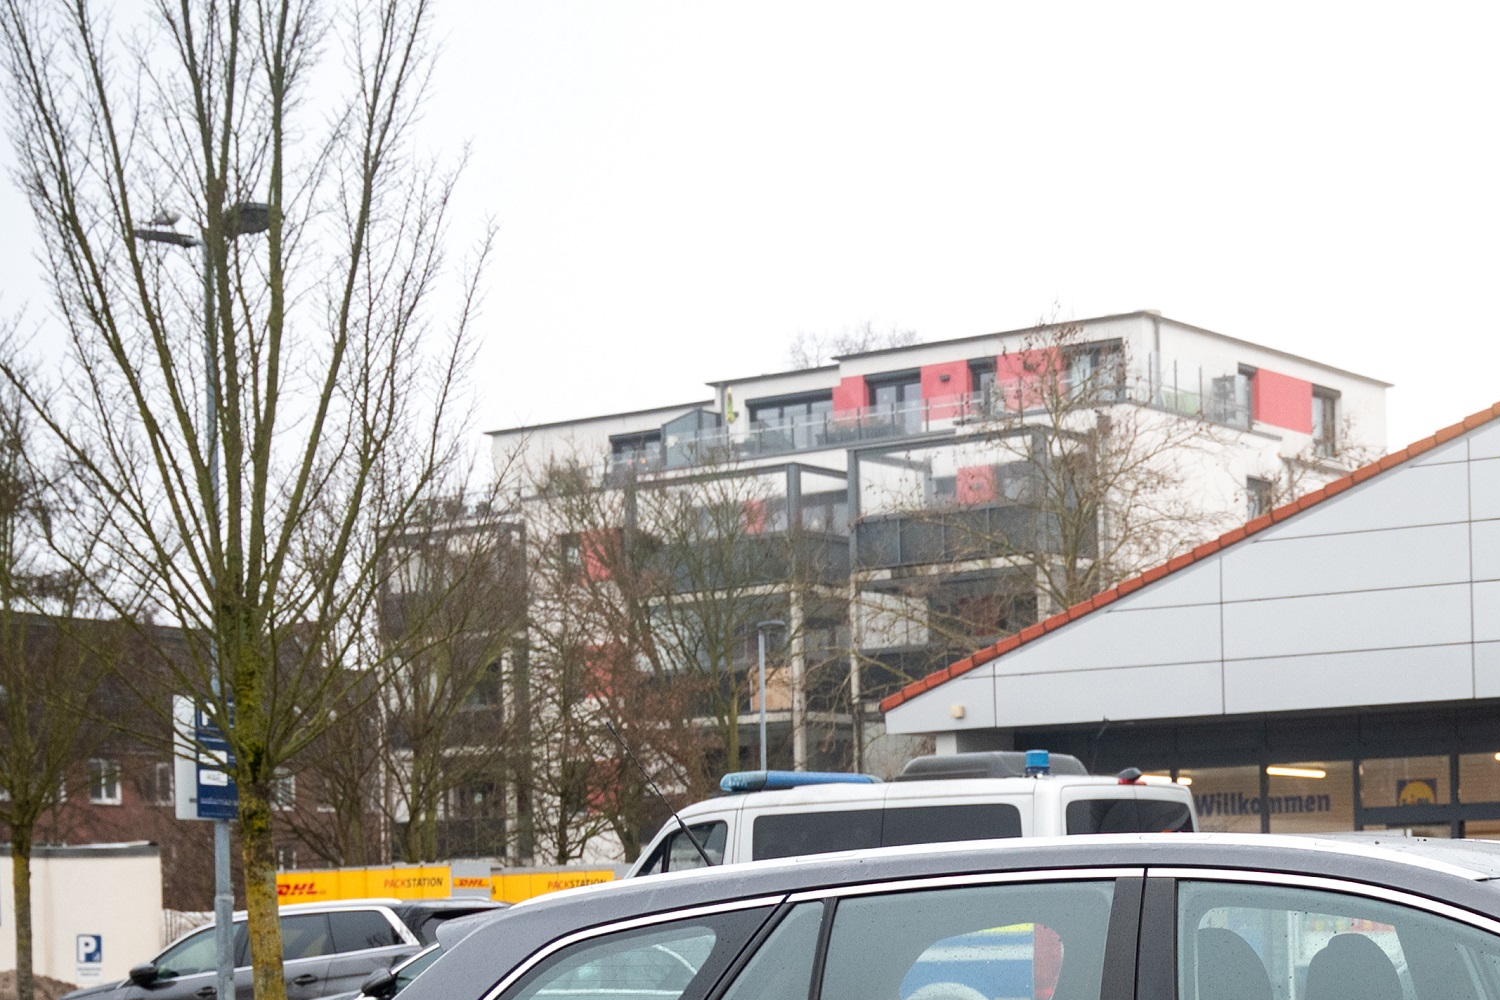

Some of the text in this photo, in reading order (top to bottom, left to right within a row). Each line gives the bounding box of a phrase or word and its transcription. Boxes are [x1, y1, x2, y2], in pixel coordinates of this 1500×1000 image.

[1195, 791, 1331, 817] Willkommen
[277, 882, 318, 896] DHL
[383, 877, 443, 889] PACKSTATION
[78, 936, 97, 963] P
